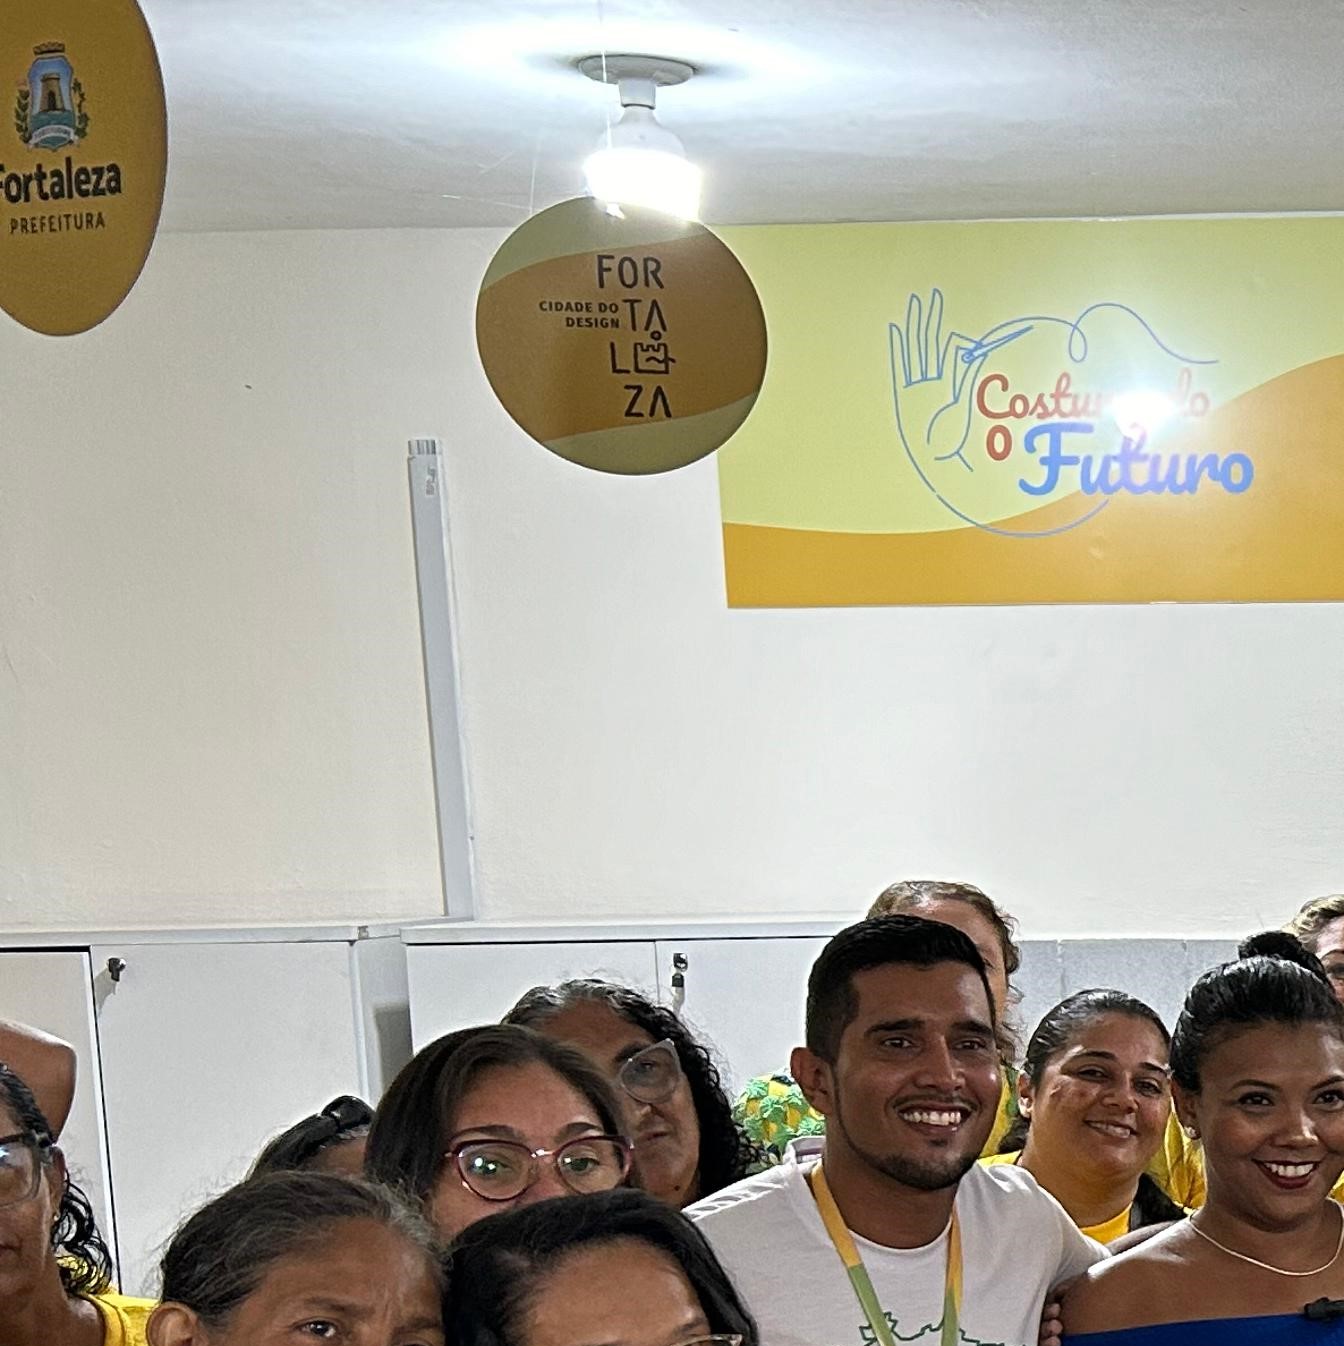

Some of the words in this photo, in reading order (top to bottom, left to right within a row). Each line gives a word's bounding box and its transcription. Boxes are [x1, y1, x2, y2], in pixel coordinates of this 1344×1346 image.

[10, 212, 105, 234] PREFEITURA
[597, 254, 665, 289] FOR
[539, 301, 593, 313] CIDADE
[598, 302, 619, 314] DO
[565, 317, 620, 329] DESIGN
[1018, 421, 1255, 497] Futuro
